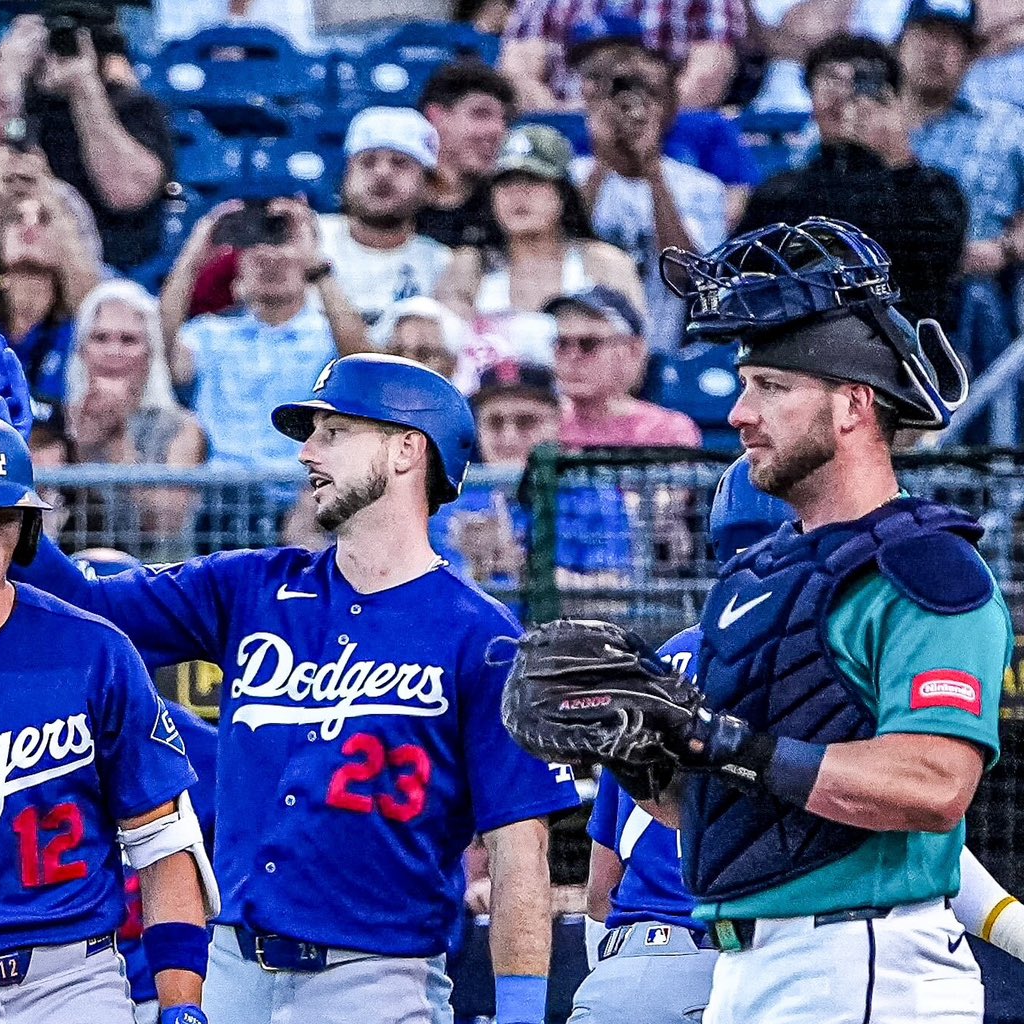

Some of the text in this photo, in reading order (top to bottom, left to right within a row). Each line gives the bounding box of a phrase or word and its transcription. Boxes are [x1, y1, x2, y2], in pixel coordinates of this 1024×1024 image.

[231, 632, 449, 741] Dodgers
[326, 732, 432, 822] 23
[12, 802, 87, 887] 12
